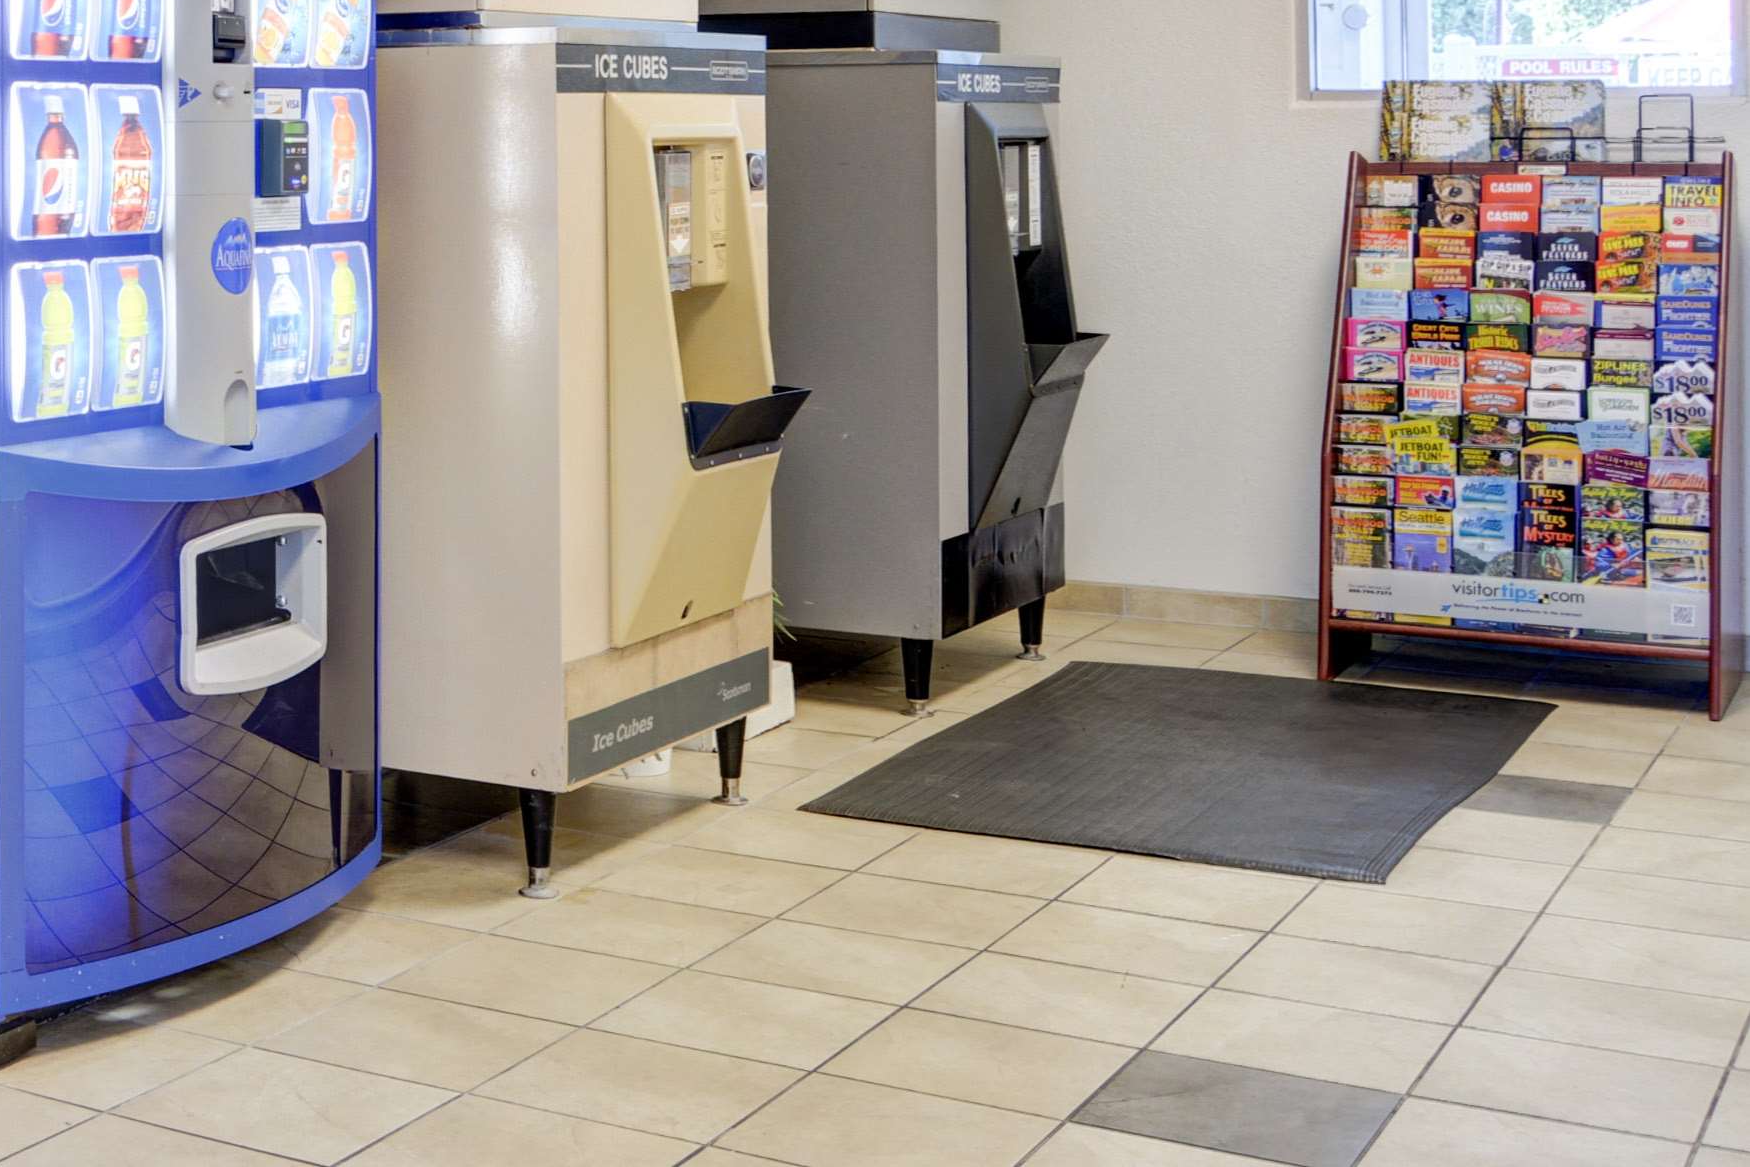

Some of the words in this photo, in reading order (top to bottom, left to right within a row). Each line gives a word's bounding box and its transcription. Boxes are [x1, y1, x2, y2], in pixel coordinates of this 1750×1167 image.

[595, 55, 619, 79] ICE
[623, 56, 669, 81] CUBES
[1508, 59, 1553, 74] POOL
[1558, 58, 1613, 74] RULES
[957, 73, 973, 92] ICE
[974, 73, 1001, 93] CUBES
[286, 99, 300, 110] VISA
[1490, 181, 1533, 194] CASINO
[1670, 185, 1718, 197] TRAVEL
[1671, 196, 1706, 208] INFO
[1486, 210, 1529, 223] CASINO
[1475, 301, 1524, 314] WINES
[1409, 352, 1460, 367] ANTIQUES
[1594, 359, 1647, 372] ZIPLINES
[1593, 373, 1638, 385] Bungee
[1406, 387, 1458, 400] ANTIQUES
[1390, 425, 1433, 438] JETBOAT
[1399, 441, 1444, 451] JETBOAT
[1416, 451, 1442, 461] FUN!
[1528, 484, 1566, 502] TREES
[1399, 511, 1444, 524] Seattle
[1530, 510, 1567, 528] TREES
[1523, 526, 1575, 543] MYSTERY
[1452, 580, 1585, 604] visitortips.com
[592, 732, 614, 753] Ice
[616, 714, 654, 743] Cubes
